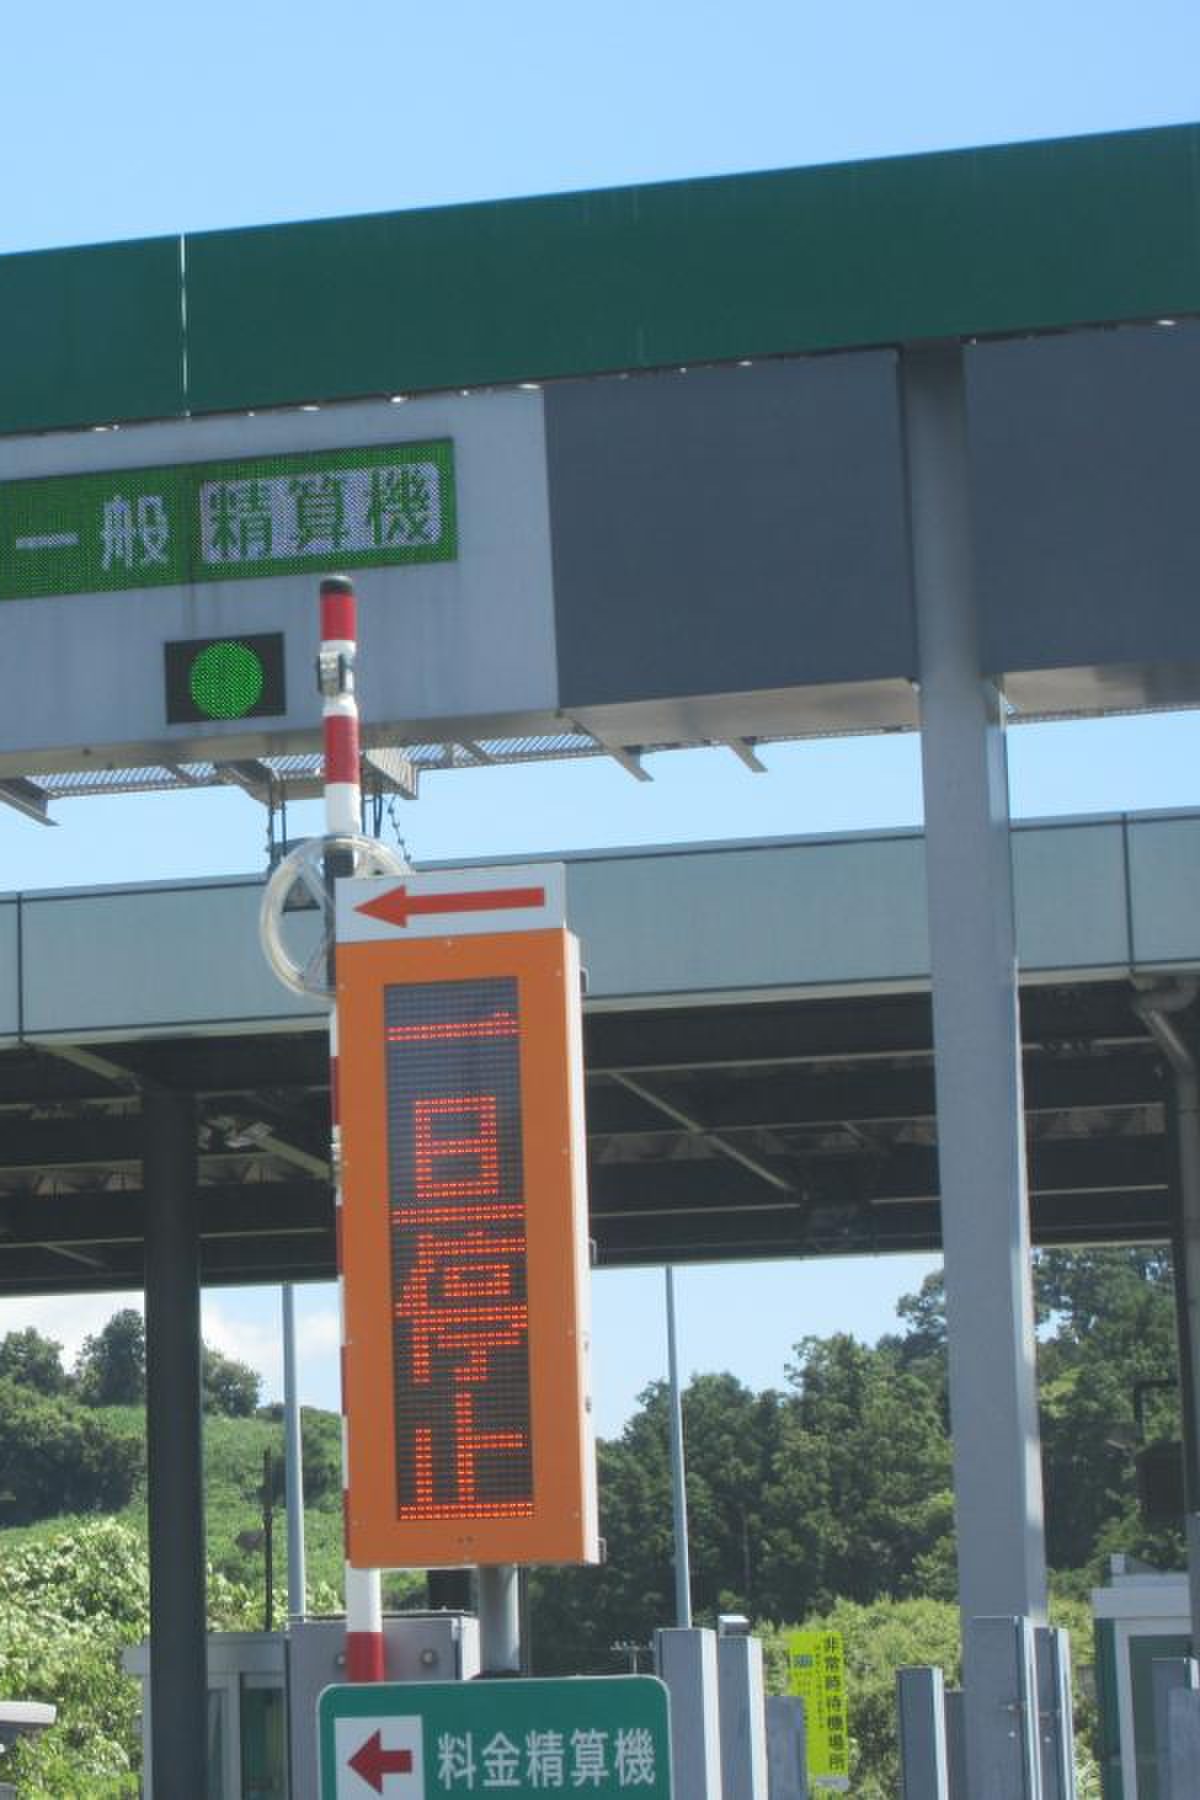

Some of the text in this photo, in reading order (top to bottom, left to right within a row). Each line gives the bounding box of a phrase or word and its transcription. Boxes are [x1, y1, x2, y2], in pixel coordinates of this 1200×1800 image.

[15, 464, 437, 572] 一般 精算機
[387, 1011, 535, 1520] 一旦停止
[437, 1728, 657, 1791] 料金精算機
